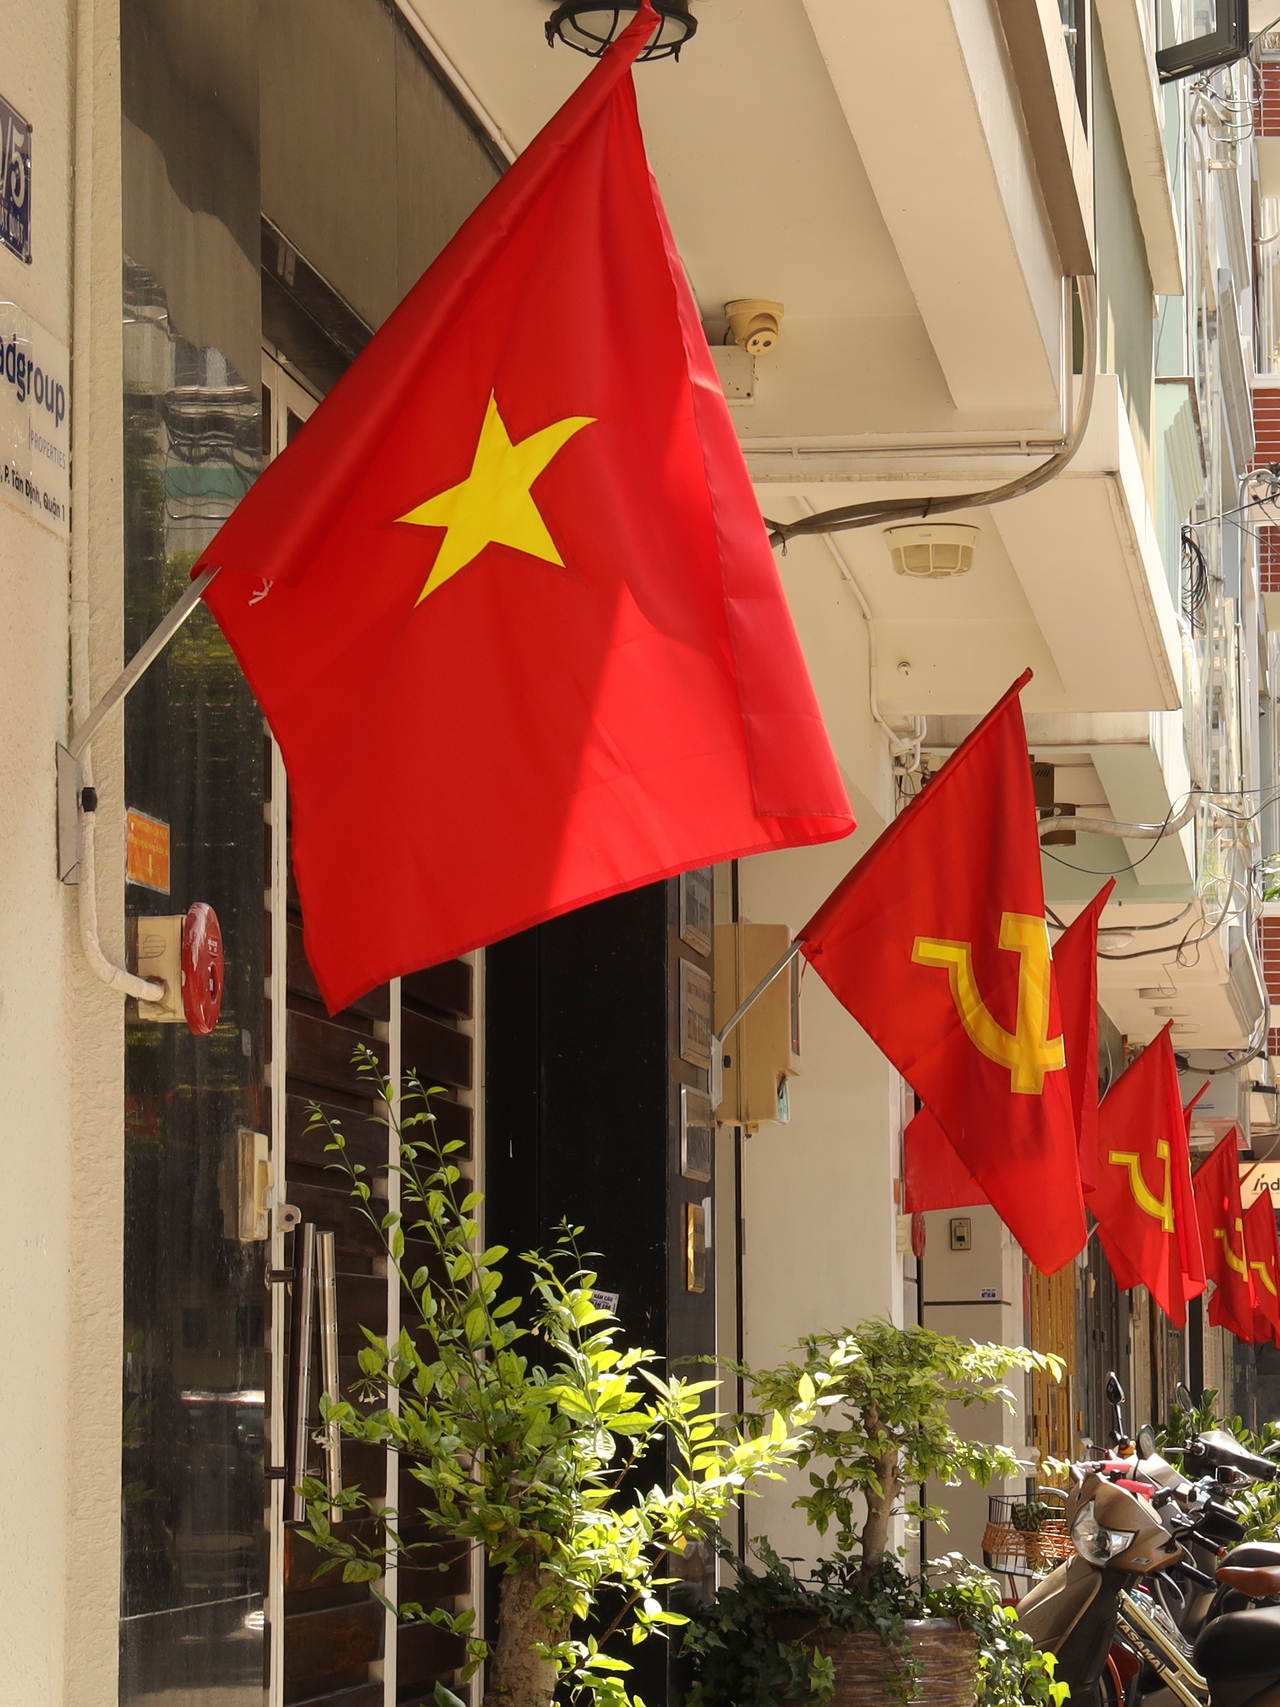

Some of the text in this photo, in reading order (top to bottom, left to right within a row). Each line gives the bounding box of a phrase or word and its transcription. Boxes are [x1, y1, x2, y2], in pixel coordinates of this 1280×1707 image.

[0, 114, 26, 208] /5
[30, 429, 66, 470] PROPERTIES
[12, 469, 24, 494] Tân
[1118, 1624, 1161, 1669] ASAMA
